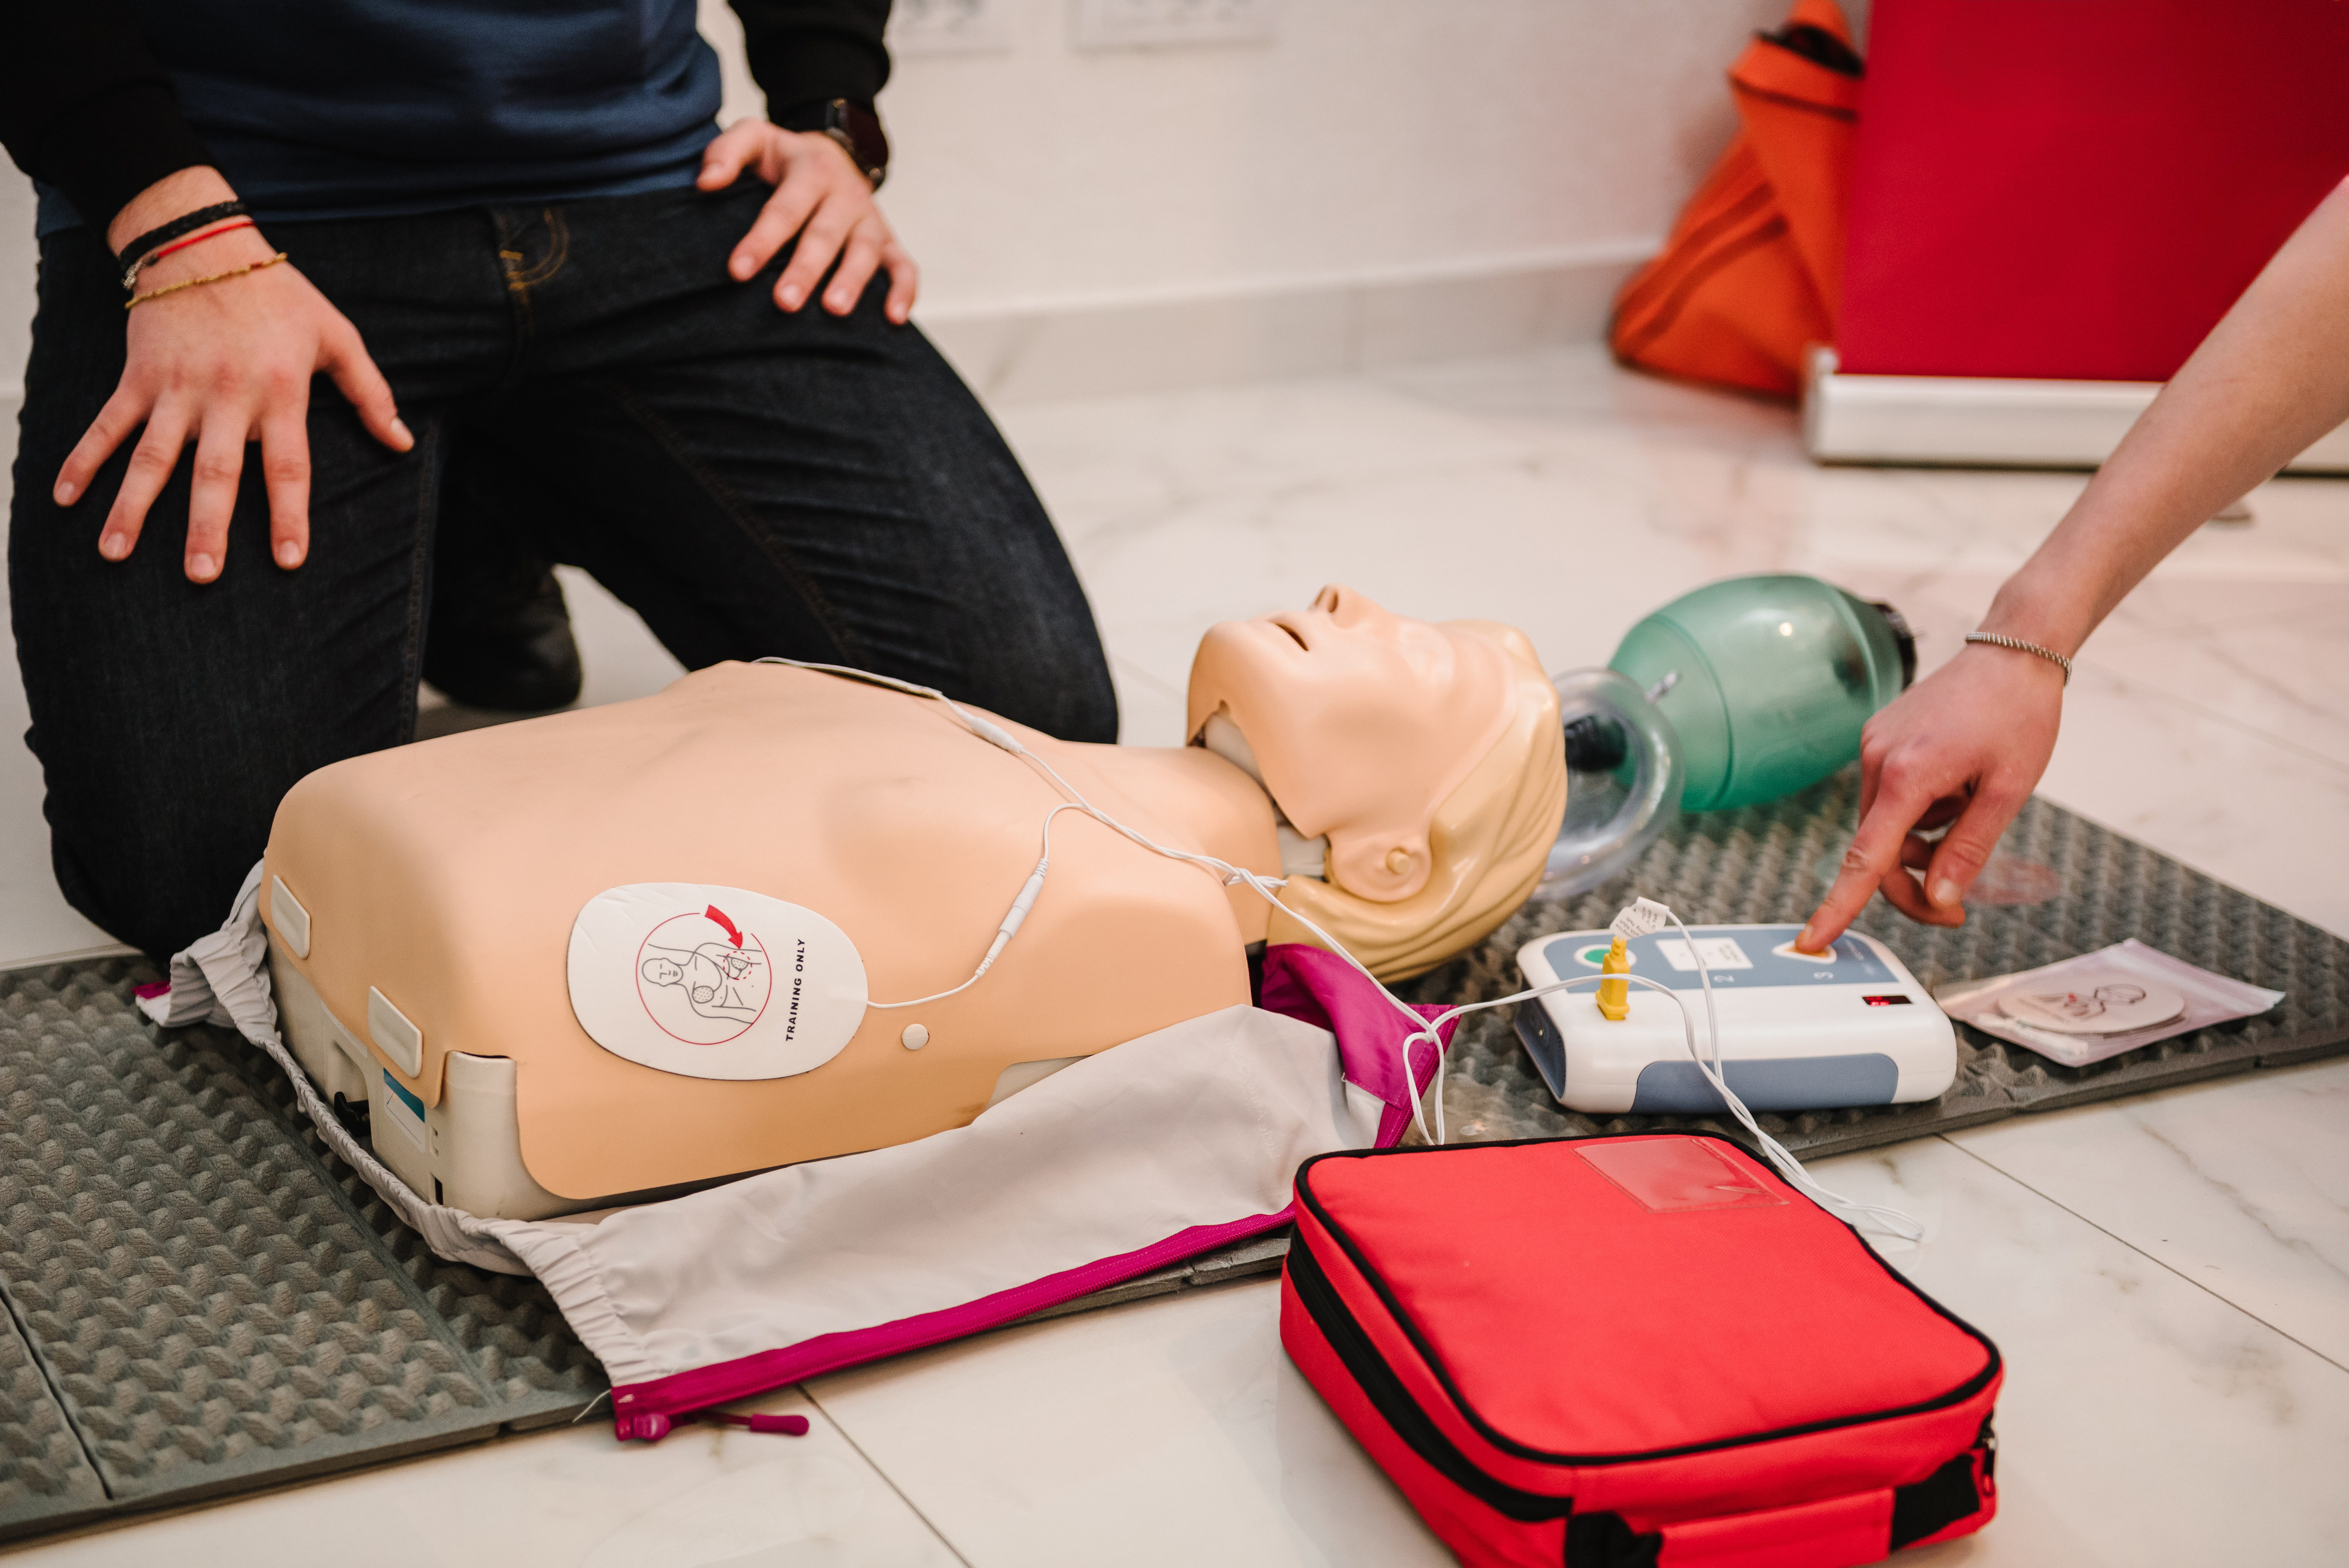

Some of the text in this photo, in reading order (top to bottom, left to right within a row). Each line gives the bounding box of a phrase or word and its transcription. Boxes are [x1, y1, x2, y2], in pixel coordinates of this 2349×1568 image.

[1620, 919, 1640, 936] with Adult
[786, 939, 805, 1041] TRAINING ONLY
